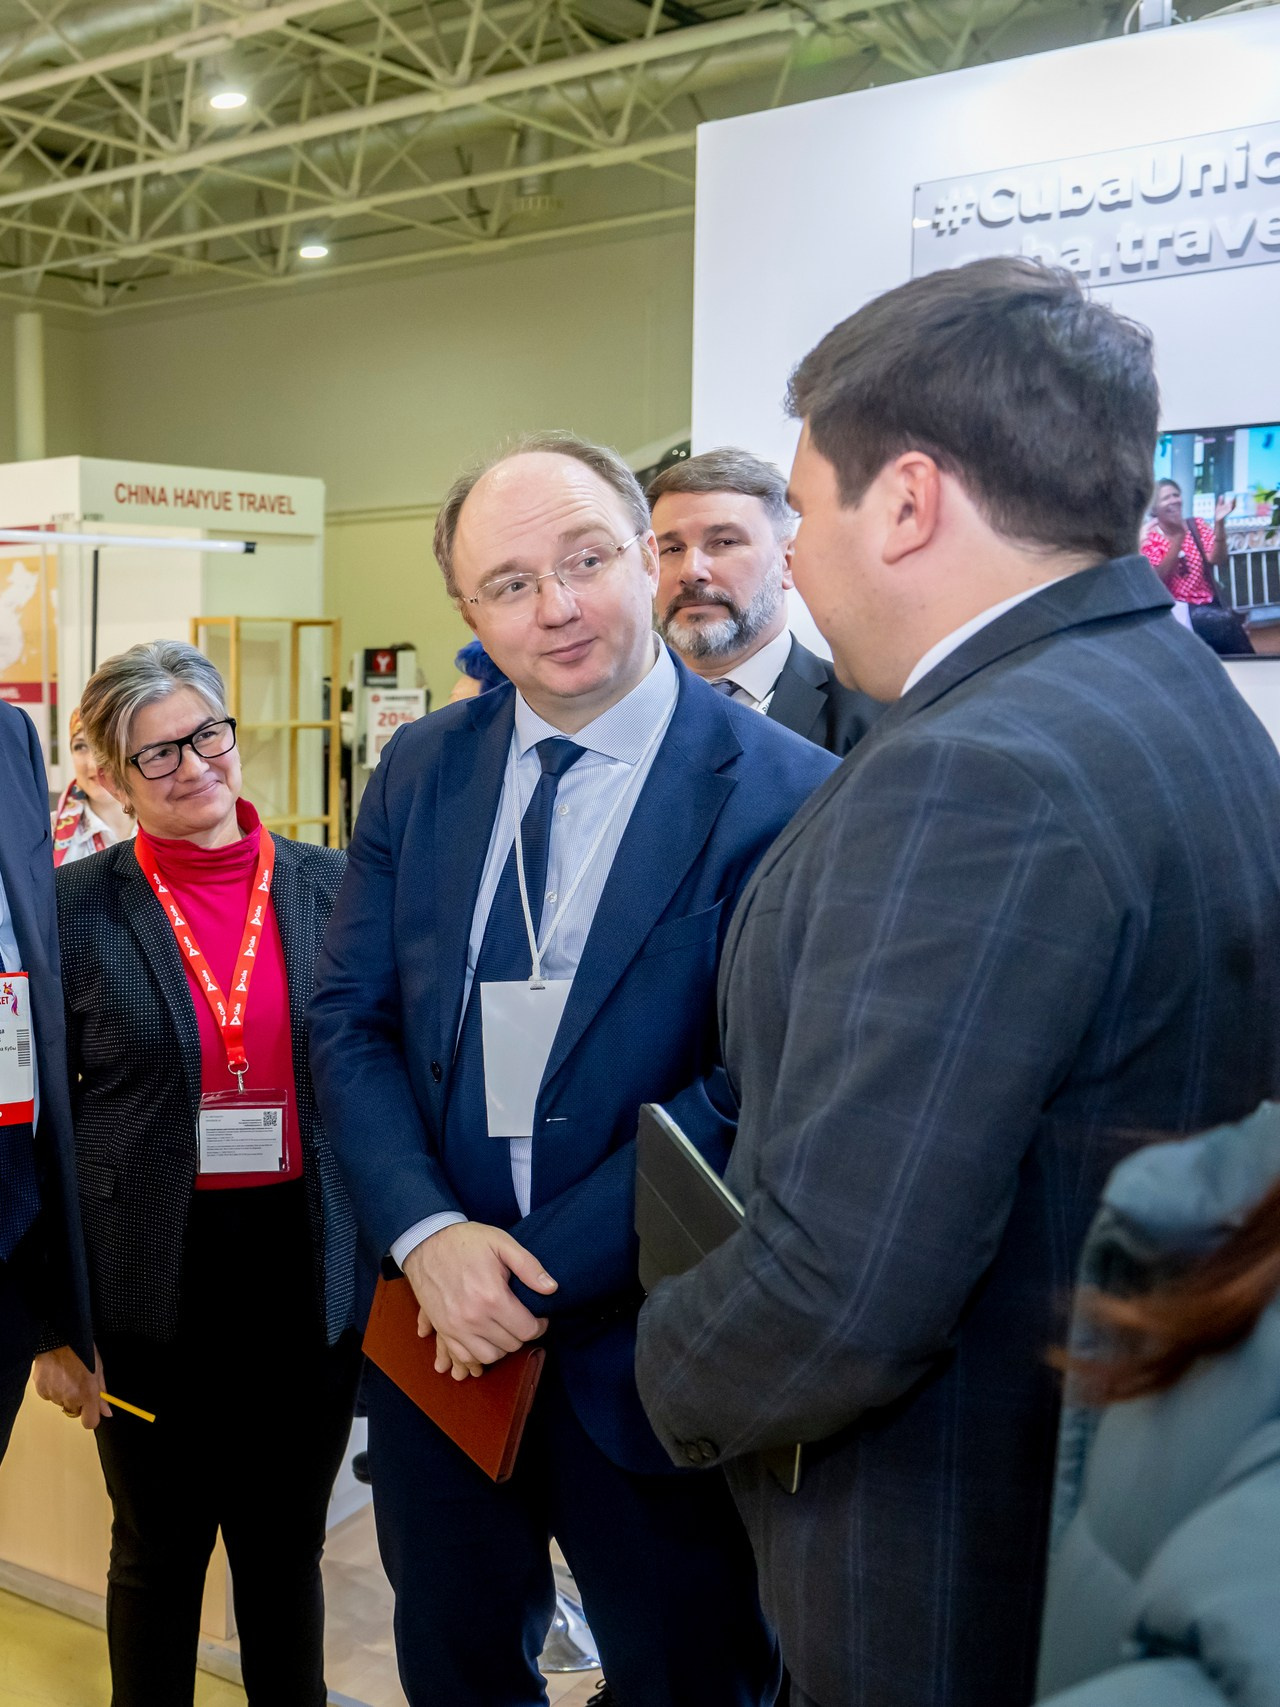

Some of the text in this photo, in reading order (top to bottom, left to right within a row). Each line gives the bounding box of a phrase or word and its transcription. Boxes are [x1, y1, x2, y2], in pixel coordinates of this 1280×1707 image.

[115, 483, 296, 516] CHINA HAIYUE TRAVEL
